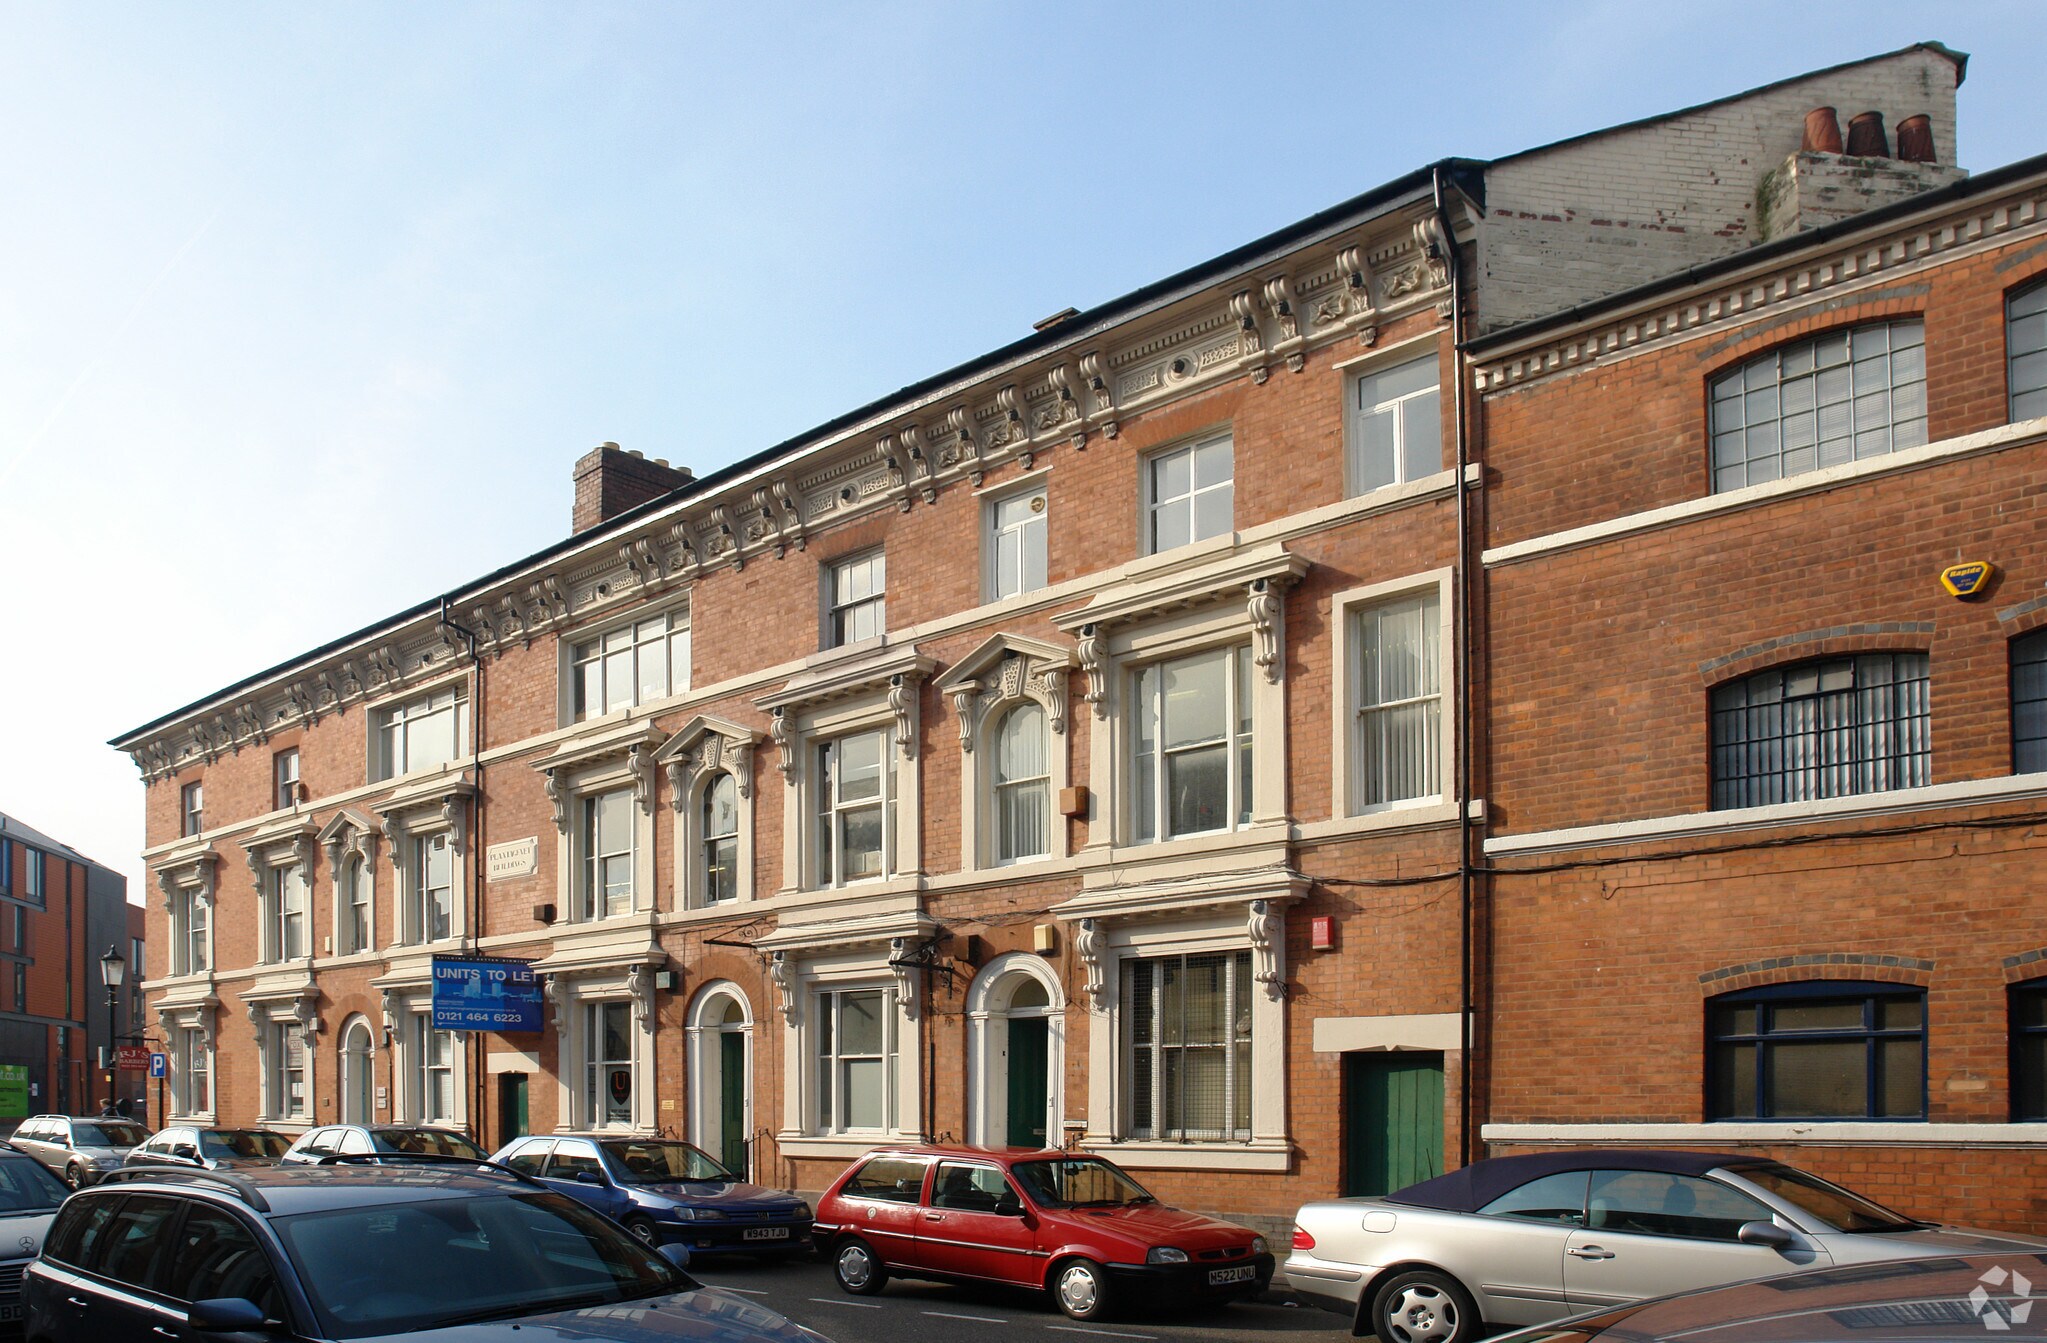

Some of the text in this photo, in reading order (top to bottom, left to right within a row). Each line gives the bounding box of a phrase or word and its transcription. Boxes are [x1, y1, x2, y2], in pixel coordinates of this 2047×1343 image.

[1949, 566, 1981, 578] Rapide
[493, 860, 526, 871] BUILDINGS
[436, 967, 537, 982] UNITS TO LET
[437, 1011, 522, 1023] 0121 464 6223
[153, 1055, 163, 1075] P
[614, 1072, 626, 1090] U
[771, 1227, 786, 1238] TJU
[1237, 1266, 1255, 1280] UNU
